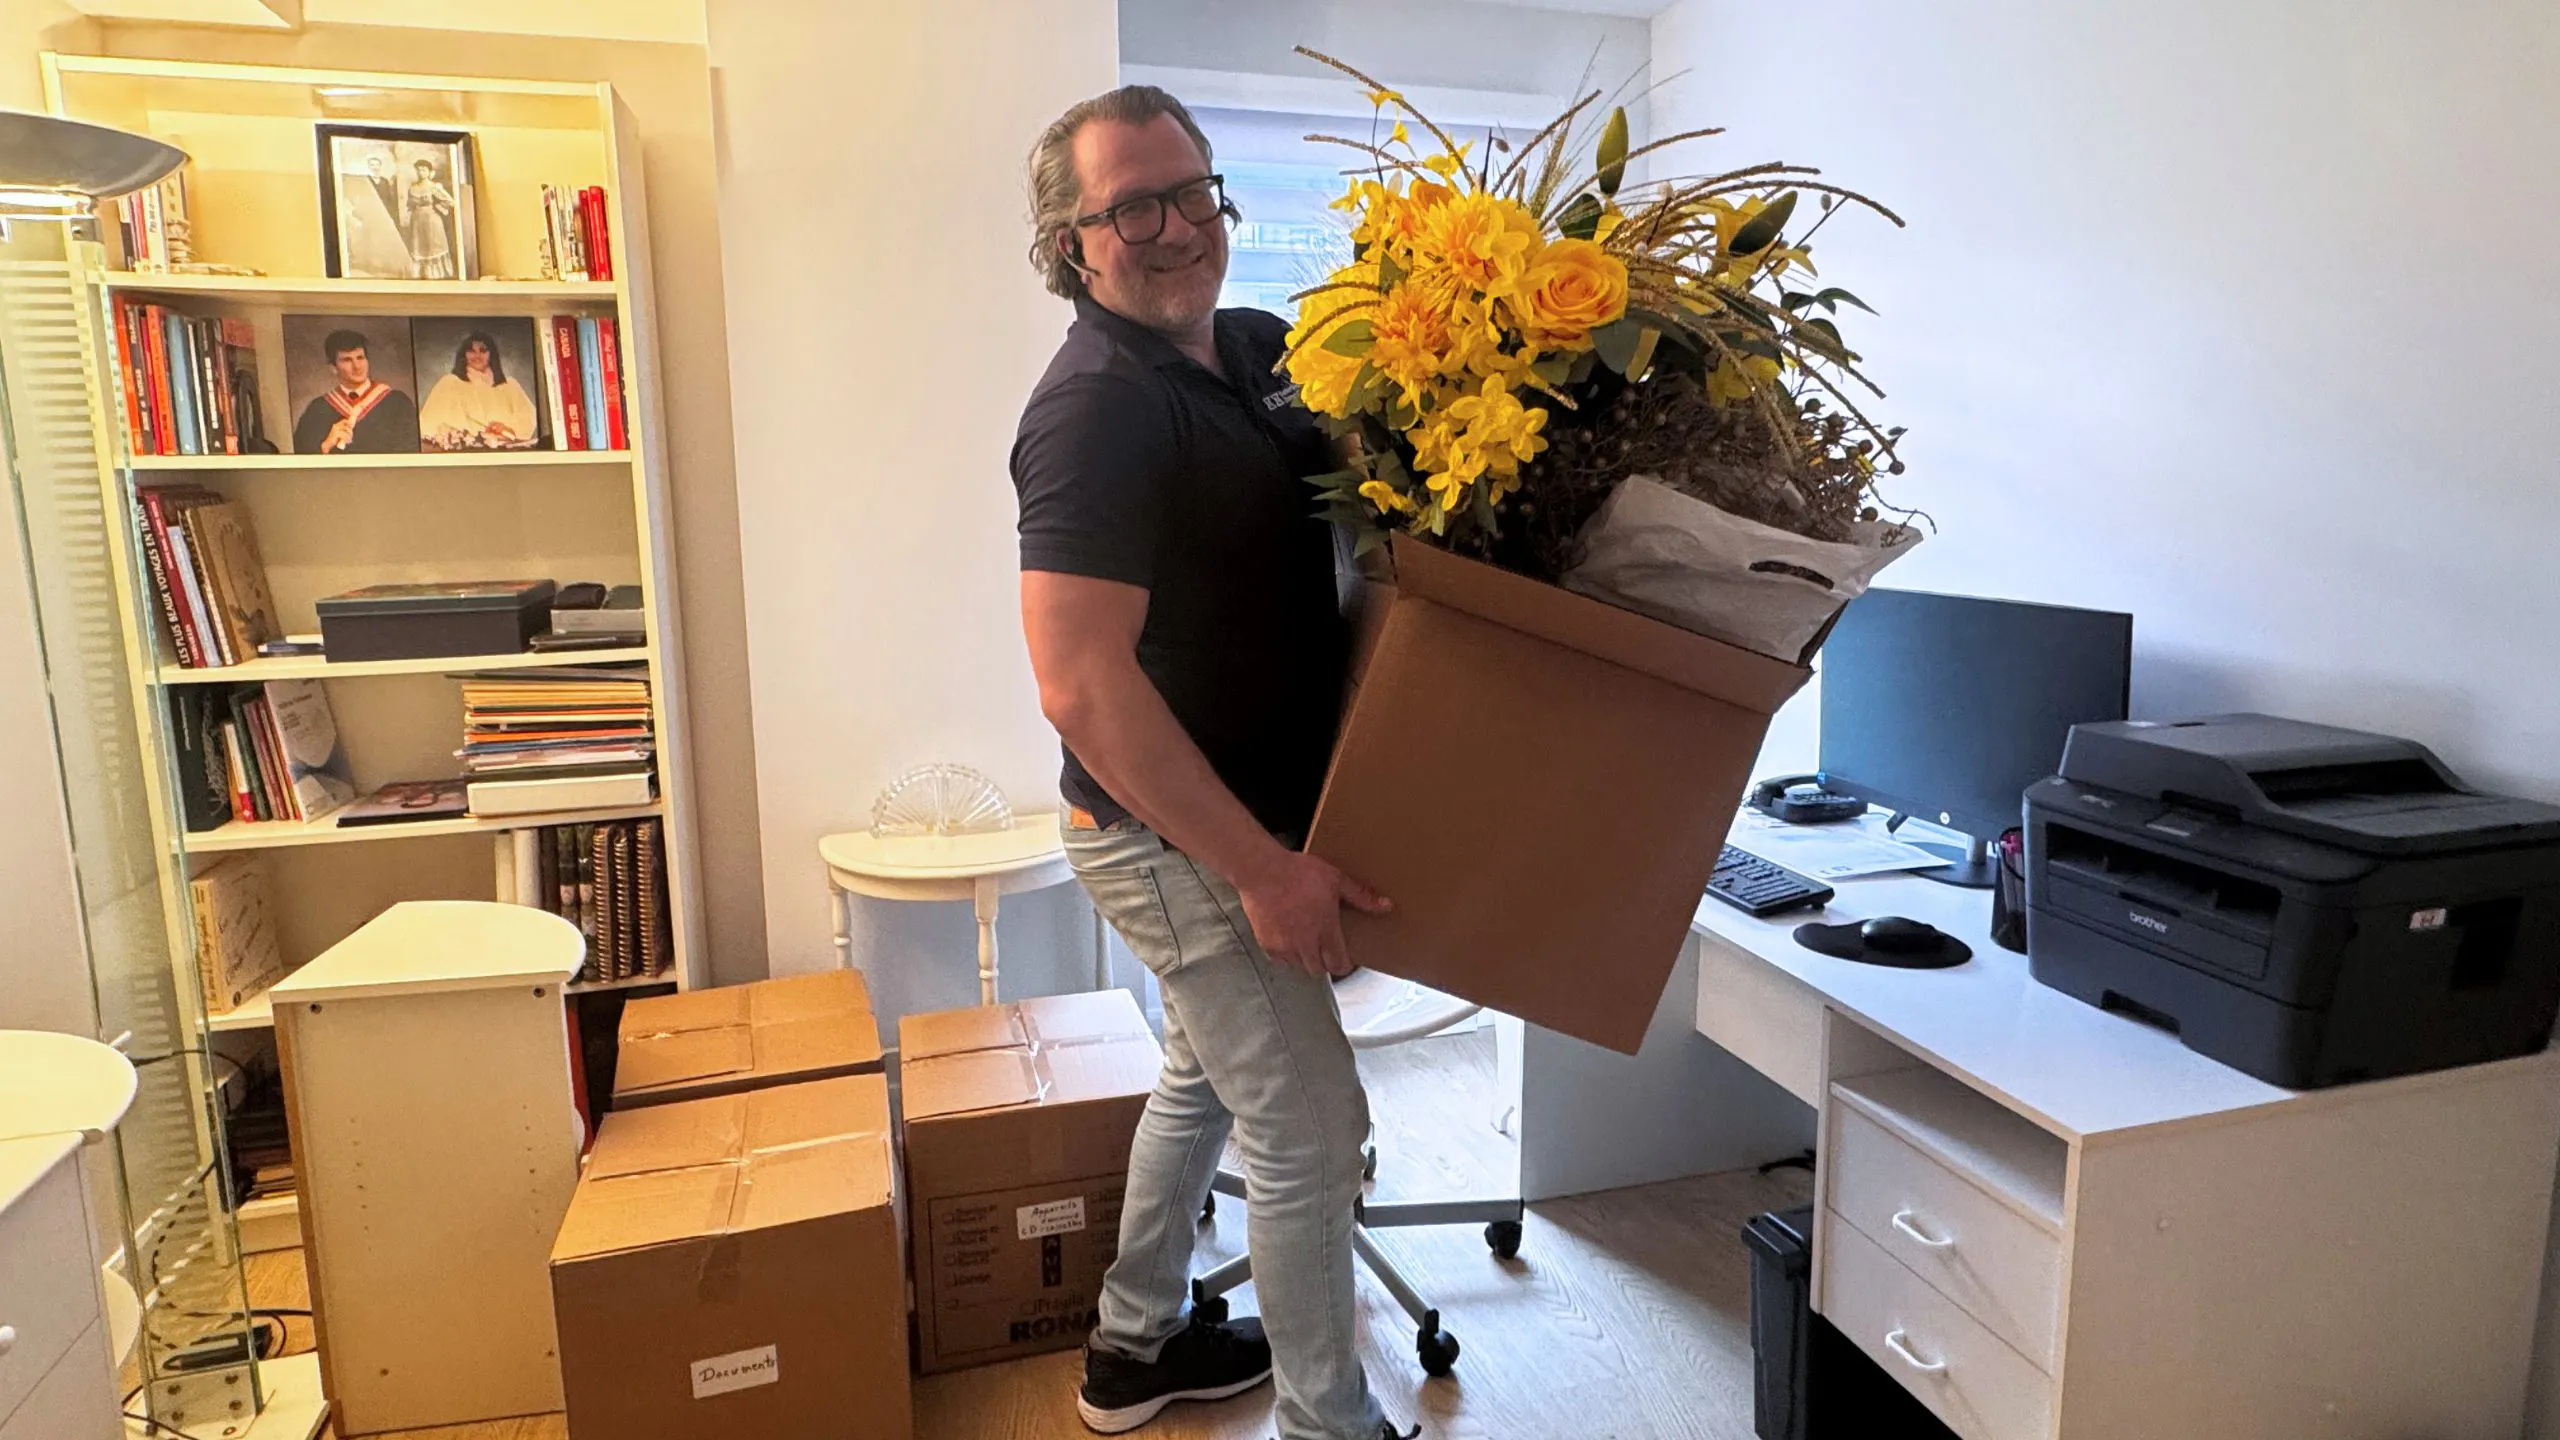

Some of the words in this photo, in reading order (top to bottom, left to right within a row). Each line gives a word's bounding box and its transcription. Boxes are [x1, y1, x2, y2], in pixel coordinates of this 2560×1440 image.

[136, 504, 151, 532] TRAIN
[144, 533, 155, 546] EN
[149, 548, 168, 590] VOYAGES
[162, 592, 178, 623] BEAUX
[172, 624, 185, 646] PLUS
[178, 647, 191, 664] LES
[2129, 911, 2167, 934] brother
[698, 1353, 776, 1383] Documents
